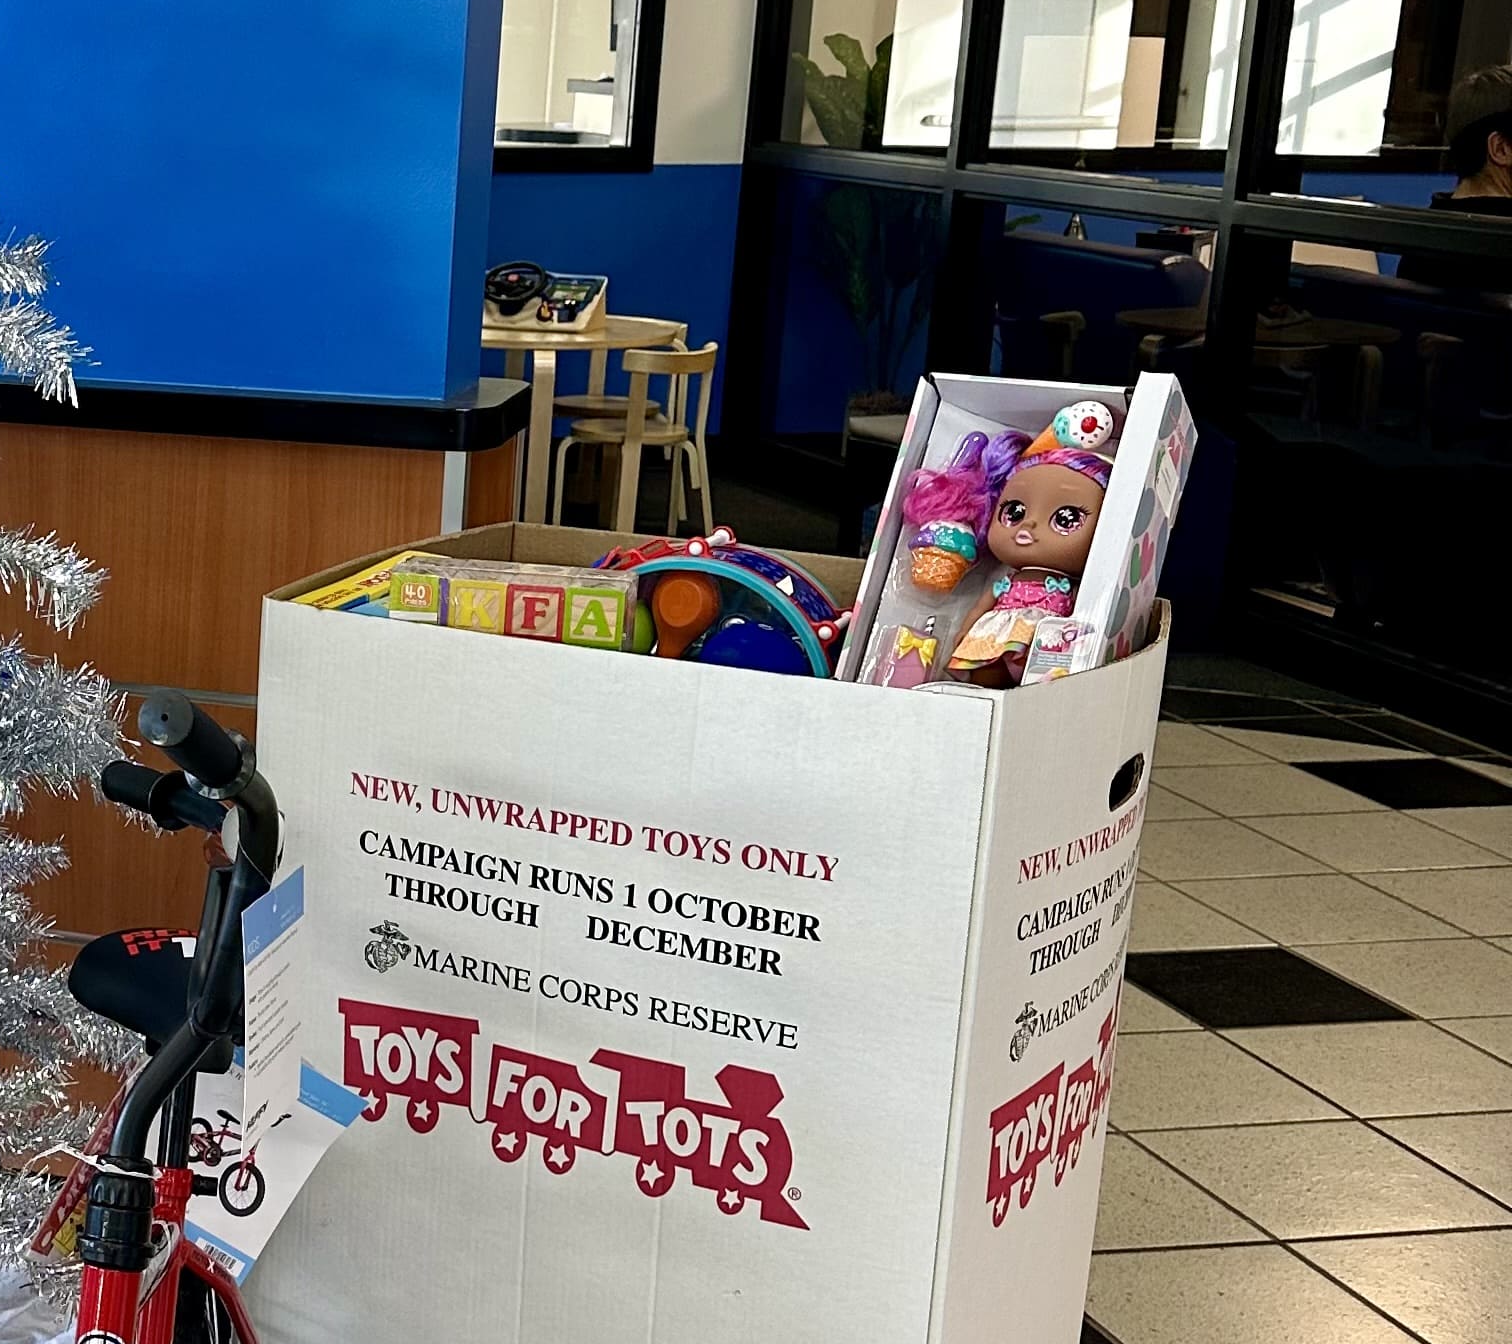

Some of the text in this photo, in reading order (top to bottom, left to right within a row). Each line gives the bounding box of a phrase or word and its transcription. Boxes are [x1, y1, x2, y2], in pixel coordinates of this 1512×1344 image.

[405, 585, 426, 599] 40
[461, 589, 610, 638] K F A
[350, 772, 840, 882] NEW, UNWRAPPED TOYS ONLY
[1017, 847, 1061, 884] NEW,
[1066, 806, 1138, 866] UNWRAPPED
[359, 830, 822, 941] CAMPAIGN RUNS 1 OCTOBER
[385, 872, 783, 976] THROUGH DECEMBER
[1017, 883, 1101, 941] CAMPAIGN
[1029, 918, 1102, 976] THROUGH
[413, 946, 799, 1049] MARINE CORPS RESERVE
[1038, 986, 1089, 1037] MARINE
[349, 1024, 464, 1094] TOYS
[492, 1058, 591, 1138] FOR
[625, 1099, 770, 1186] TOTS
[995, 1080, 1094, 1179] TOYS FOR
